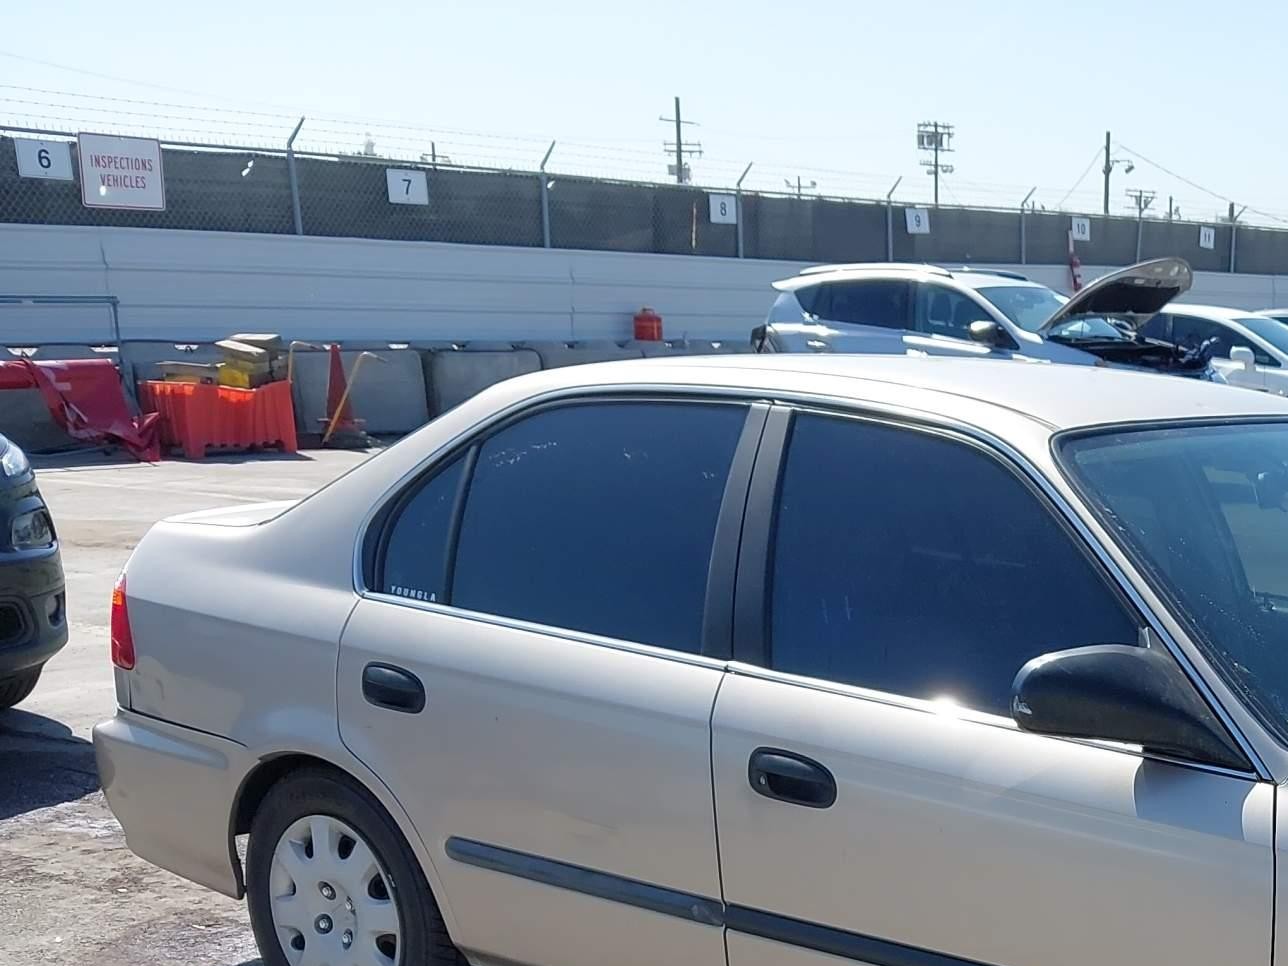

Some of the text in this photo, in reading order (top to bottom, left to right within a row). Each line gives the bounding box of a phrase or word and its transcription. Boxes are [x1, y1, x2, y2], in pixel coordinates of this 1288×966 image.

[37, 148, 52, 169] 6
[89, 154, 153, 172] INSPECTIONS
[99, 173, 147, 190] VEHICLES
[401, 178, 412, 195] 7
[720, 201, 727, 217] 8
[914, 214, 921, 228] 9
[1076, 223, 1086, 235] 10
[390, 584, 437, 602] YOUNGLA
